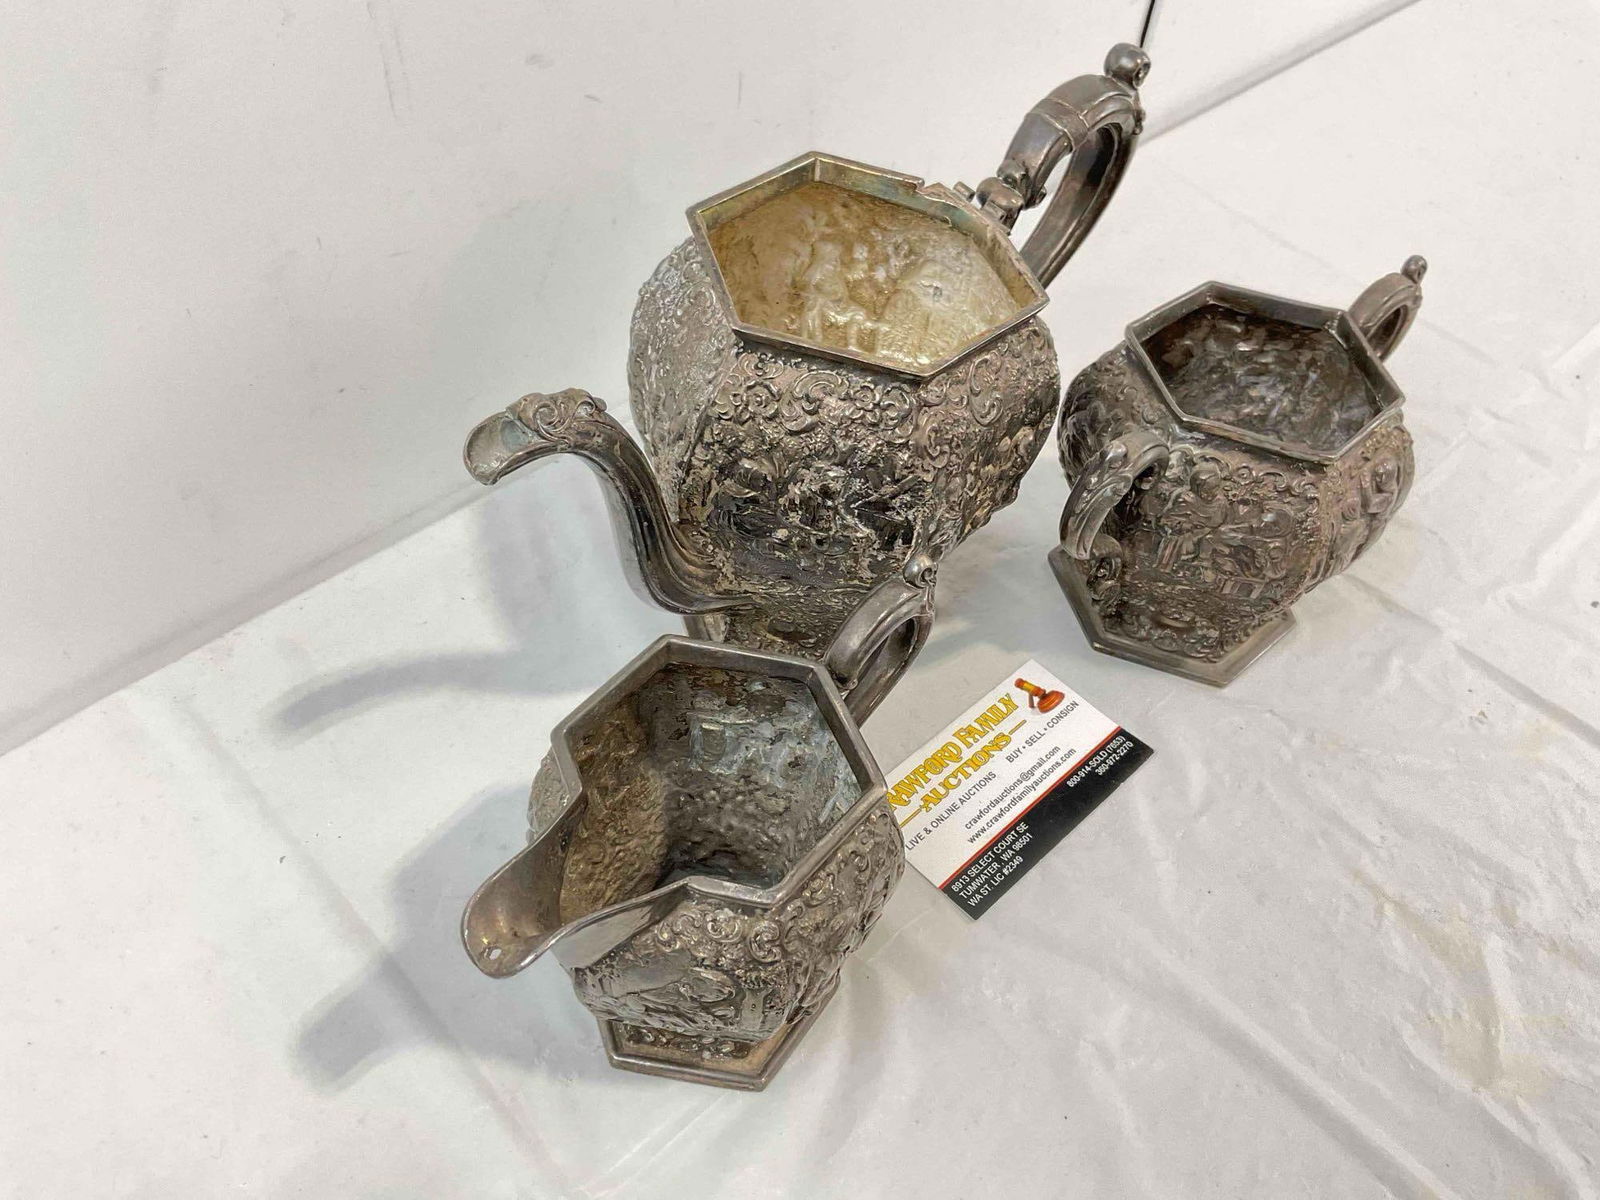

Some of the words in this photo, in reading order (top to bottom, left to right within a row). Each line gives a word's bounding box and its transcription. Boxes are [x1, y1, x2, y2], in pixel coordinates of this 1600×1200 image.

[1005, 747, 1023, 763] BUY
[1024, 731, 1045, 747] SELL
[1046, 701, 1079, 729] CONSIGN
[1066, 750, 1108, 788] 800-914-SOLD
[1106, 735, 1126, 753] (7653)
[1095, 741, 1134, 776] 360-972-2270
[888, 741, 963, 811] RAWFORD
[921, 732, 1012, 812] AUCTIONS
[965, 746, 1060, 830] crawfordauctions@gmail.com
[967, 748, 1077, 844] www.crawfordfamilyauctions.com
[905, 833, 925, 851] LIVE
[923, 827, 932, 835] &
[930, 802, 960, 828] ONLINE
[958, 771, 996, 805] AUCTIONS
[951, 875, 970, 892] 8913
[967, 851, 995, 877] SELECT
[993, 830, 1018, 854] COURT
[1016, 821, 1029, 833] SE
[967, 894, 983, 907] WA
[980, 884, 994, 896] ST.
[990, 872, 1005, 886] LIC
[1002, 856, 1024, 876] #2349
[1000, 849, 1015, 861] WA
[1012, 832, 1033, 851] 98501
